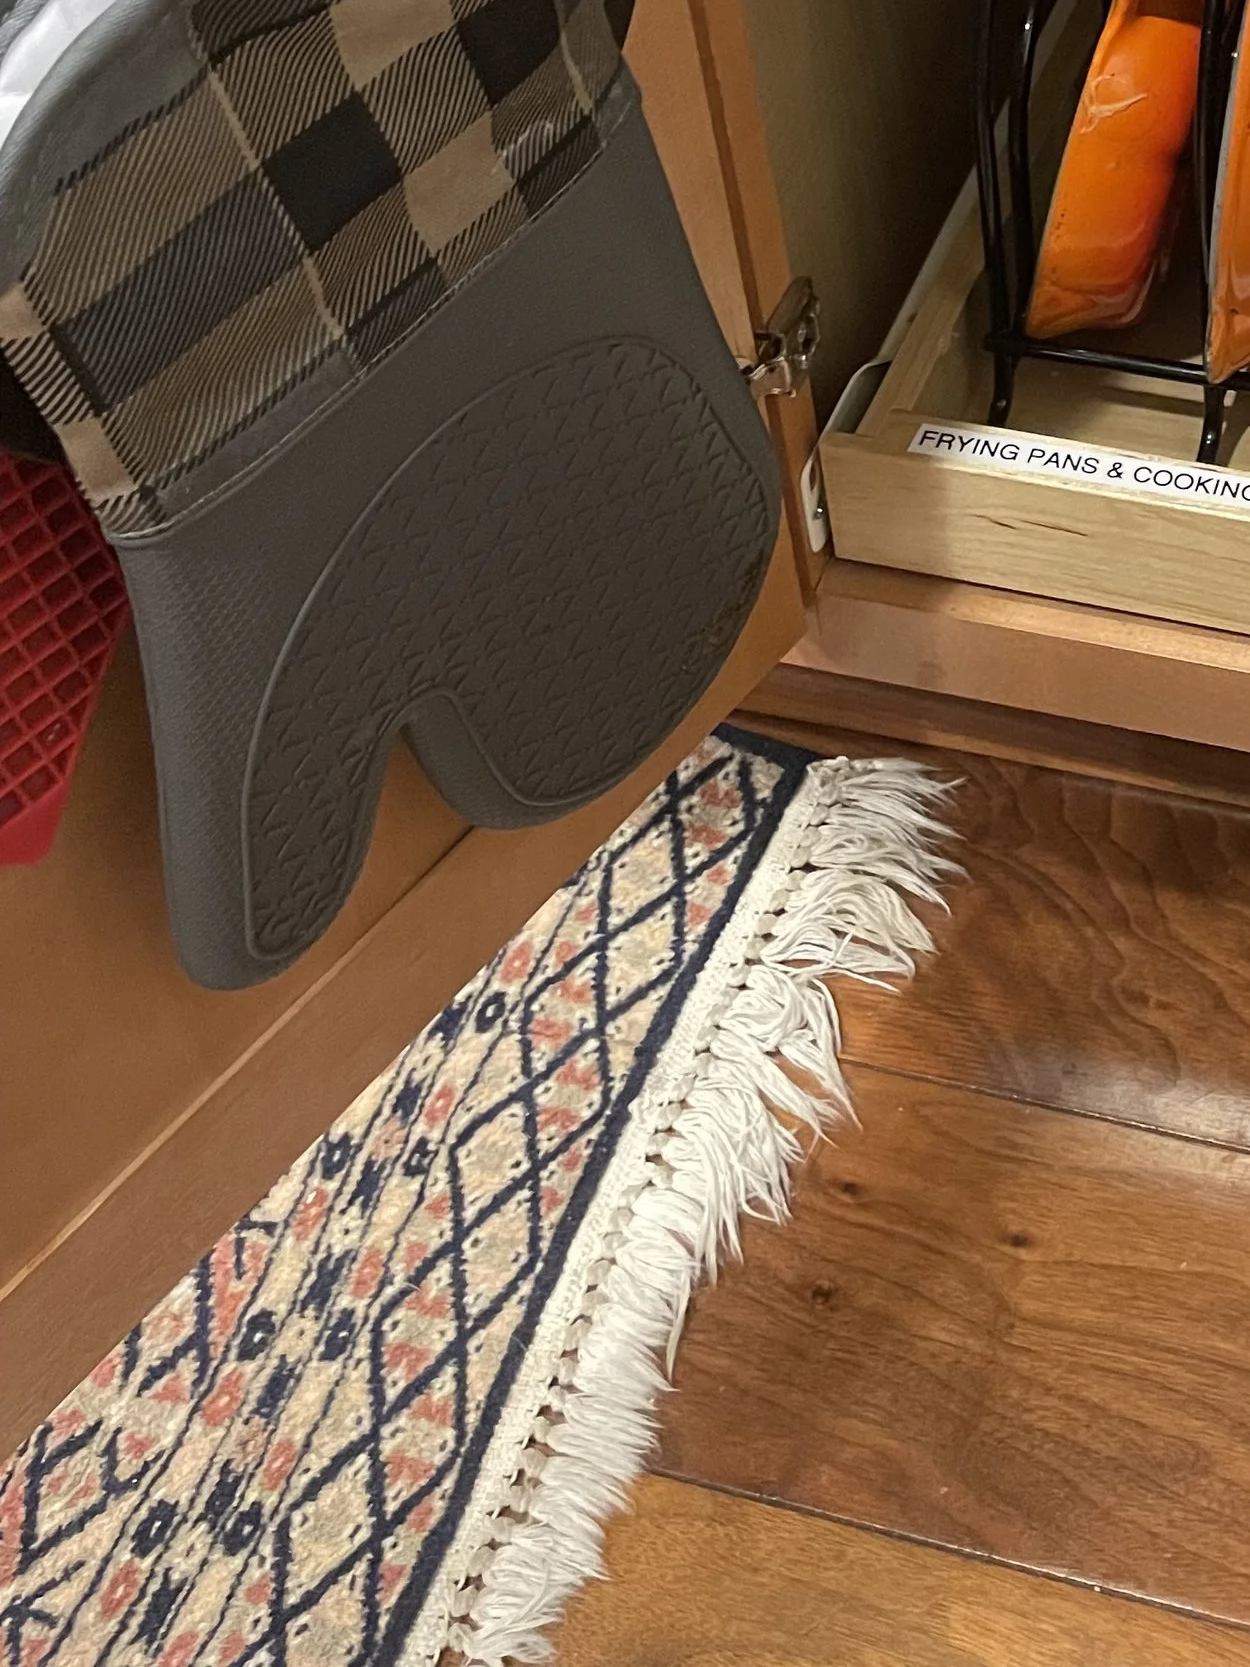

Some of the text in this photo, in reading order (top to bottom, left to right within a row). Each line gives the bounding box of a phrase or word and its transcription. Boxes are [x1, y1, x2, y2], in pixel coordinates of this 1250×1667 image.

[917, 428, 1020, 461] FRYING
[1026, 448, 1100, 474] PANS
[1106, 462, 1124, 479] &
